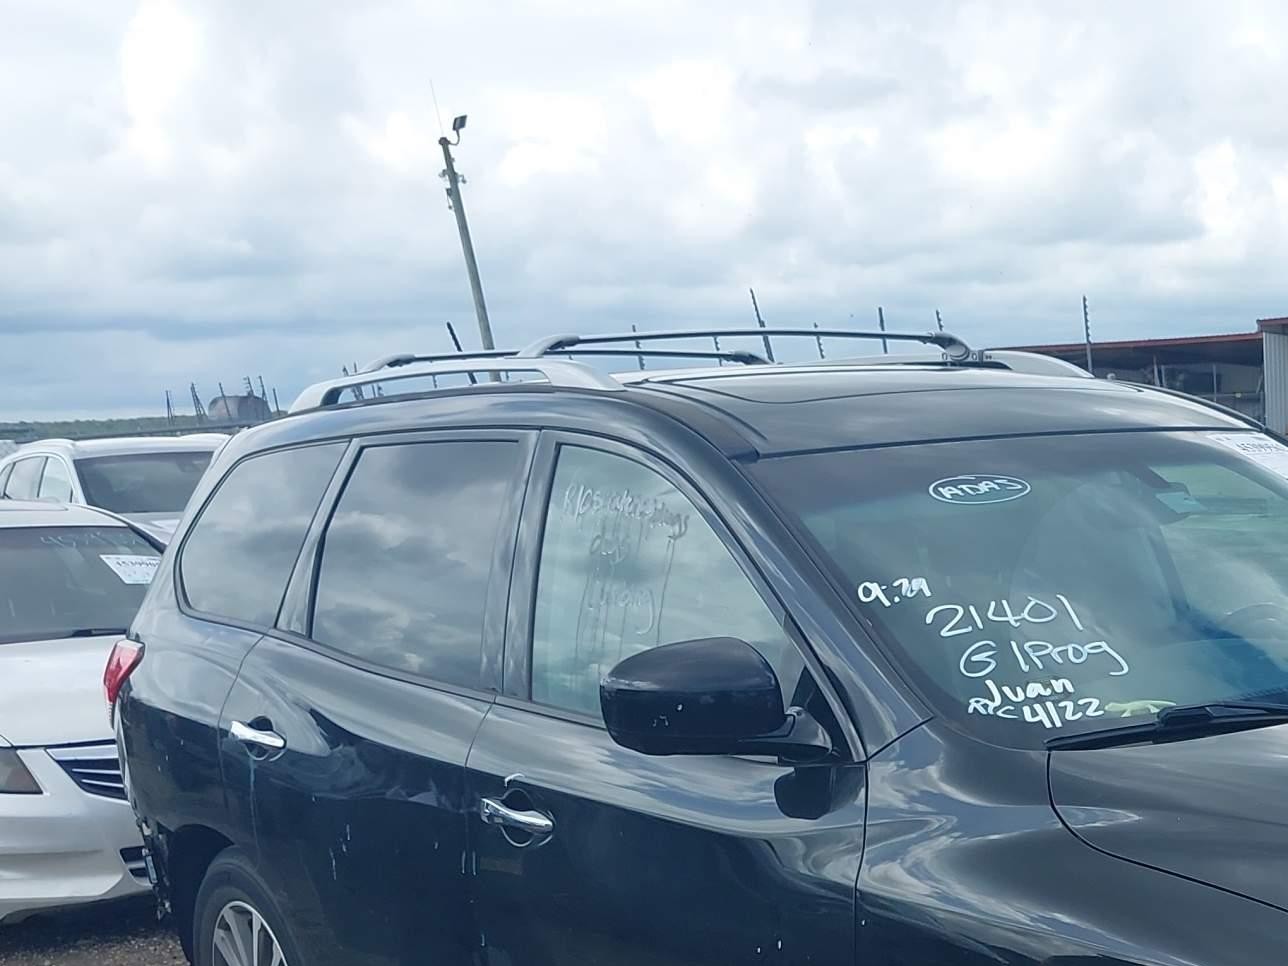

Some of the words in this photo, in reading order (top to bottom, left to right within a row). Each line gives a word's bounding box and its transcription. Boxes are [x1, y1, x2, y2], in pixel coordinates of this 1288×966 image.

[938, 479, 1023, 499] ADAS
[925, 594, 1084, 637] 21401
[985, 679, 1075, 707] Juan
